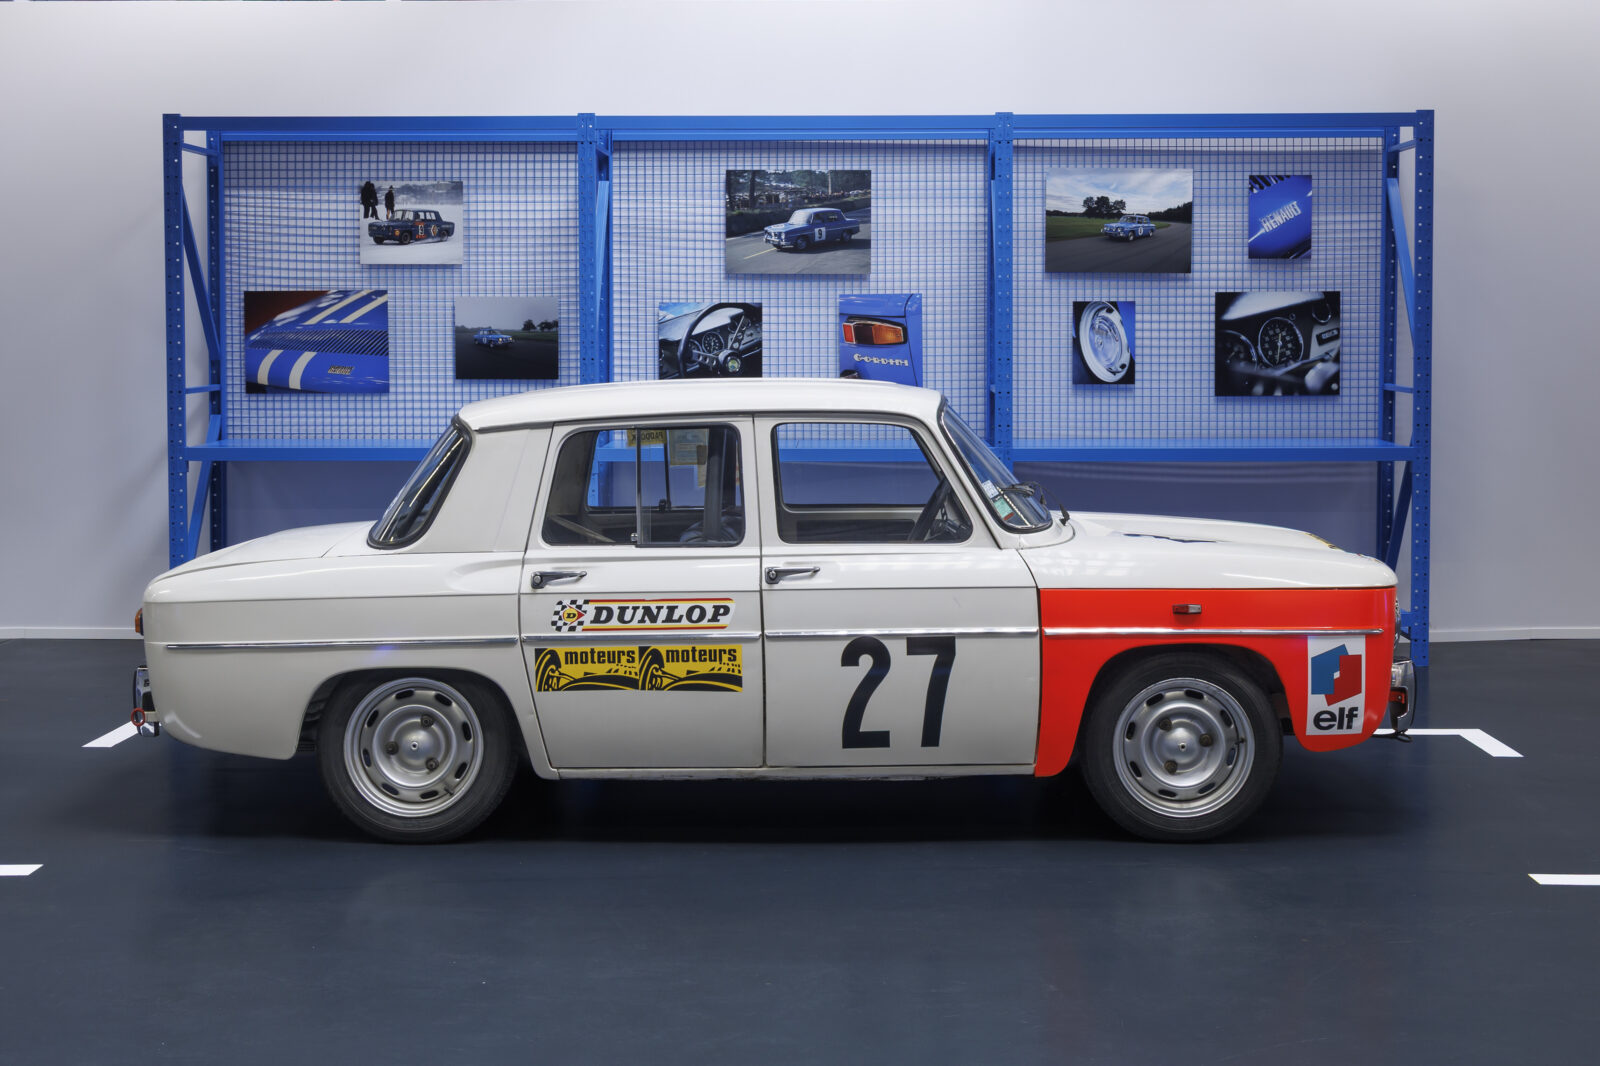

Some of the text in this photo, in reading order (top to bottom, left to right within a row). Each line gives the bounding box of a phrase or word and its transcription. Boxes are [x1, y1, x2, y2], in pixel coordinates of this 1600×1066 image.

[1261, 201, 1301, 232] RENAULT
[818, 228, 823, 239] 9
[590, 605, 731, 624] DUNLOP
[564, 648, 636, 664] moteurs
[666, 646, 737, 663] moteurs
[841, 636, 956, 749] 27
[1313, 707, 1359, 730] elf
